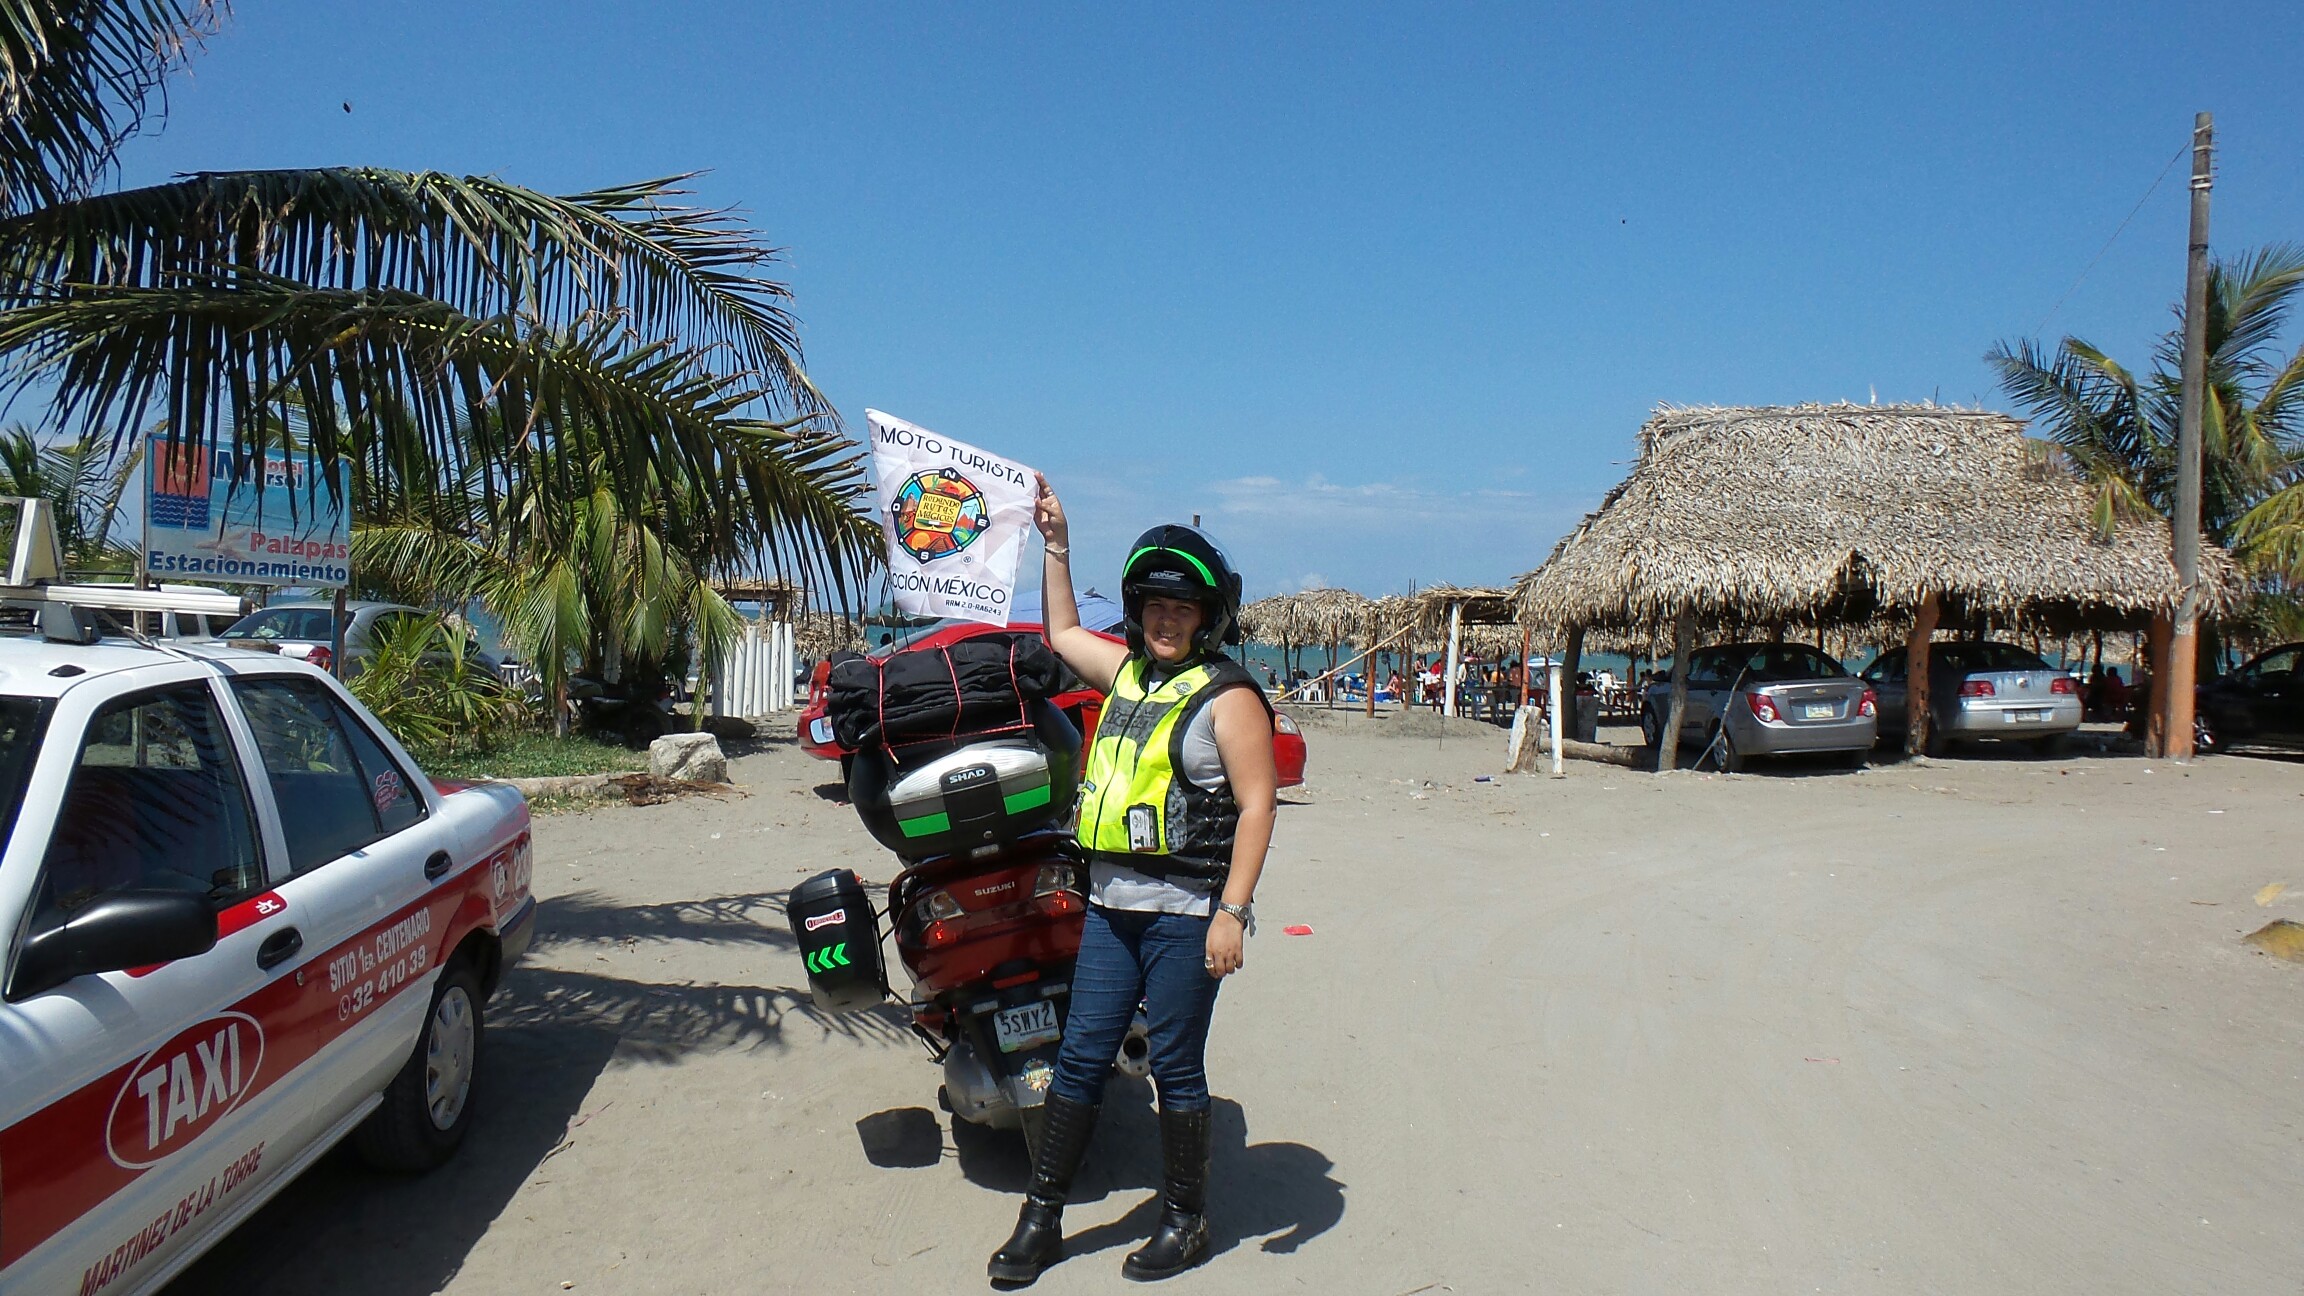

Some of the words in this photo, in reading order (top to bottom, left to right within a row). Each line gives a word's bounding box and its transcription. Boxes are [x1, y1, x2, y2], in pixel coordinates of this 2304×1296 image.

[263, 456, 303, 474] otel
[880, 425, 942, 454] MOTO
[948, 445, 1025, 488] TURISTA
[250, 532, 348, 560] Palapas
[147, 550, 347, 583] Estacionamiento
[933, 575, 1006, 604] MÉXICO
[946, 599, 961, 607] RRM
[949, 768, 986, 784] SHAD
[974, 881, 1016, 897] SUZUKI
[329, 951, 356, 993] SITIO
[376, 906, 430, 964] CENTENARIO
[352, 980, 374, 1014] 32
[378, 958, 405, 994] 410
[409, 944, 426, 974] 39
[137, 1022, 240, 1151] TAXI
[169, 1190, 197, 1237] DE
[194, 1176, 217, 1218] LA
[218, 1140, 266, 1200] TORRE
